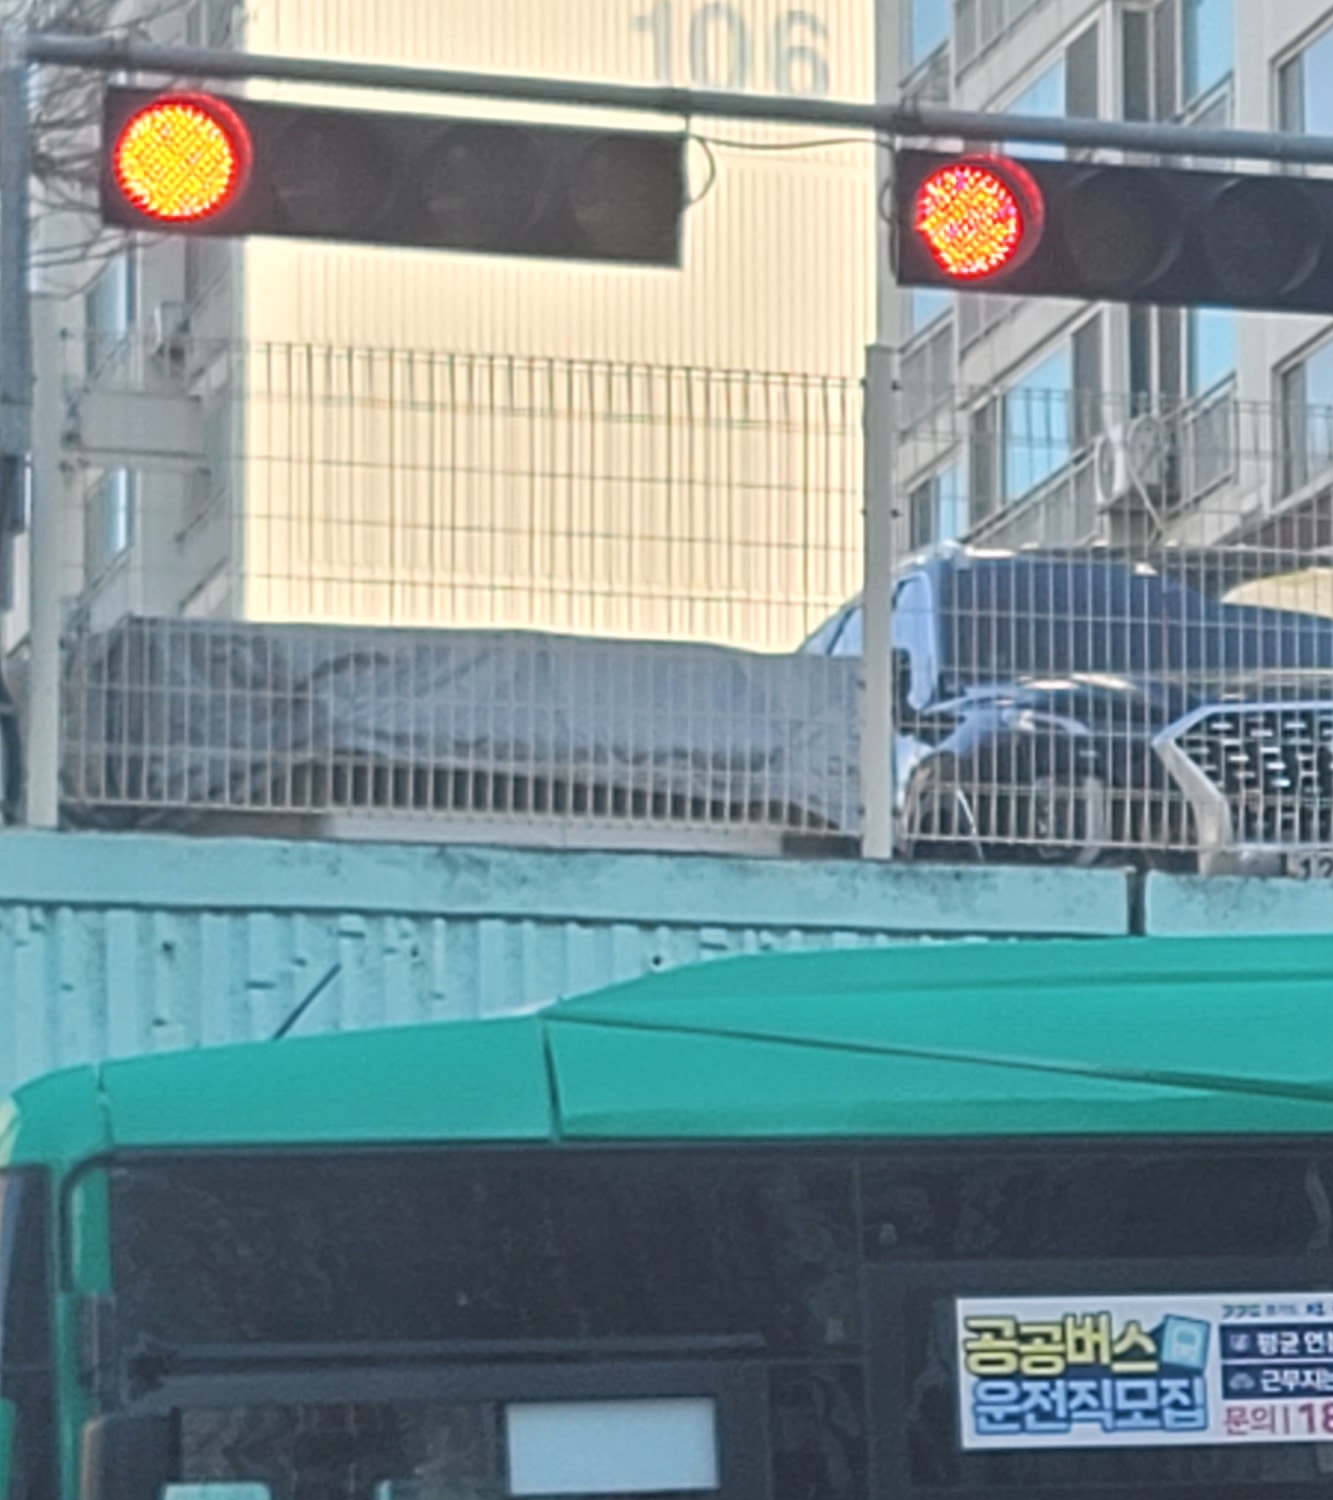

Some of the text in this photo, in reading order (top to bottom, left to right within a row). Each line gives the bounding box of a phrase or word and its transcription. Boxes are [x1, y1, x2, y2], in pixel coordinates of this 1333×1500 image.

[632, 0, 829, 97] 106
[963, 1311, 1160, 1377] 공공버스
[973, 1377, 1208, 1435] 운전직모집
[1224, 1405, 1276, 1435] 문의
